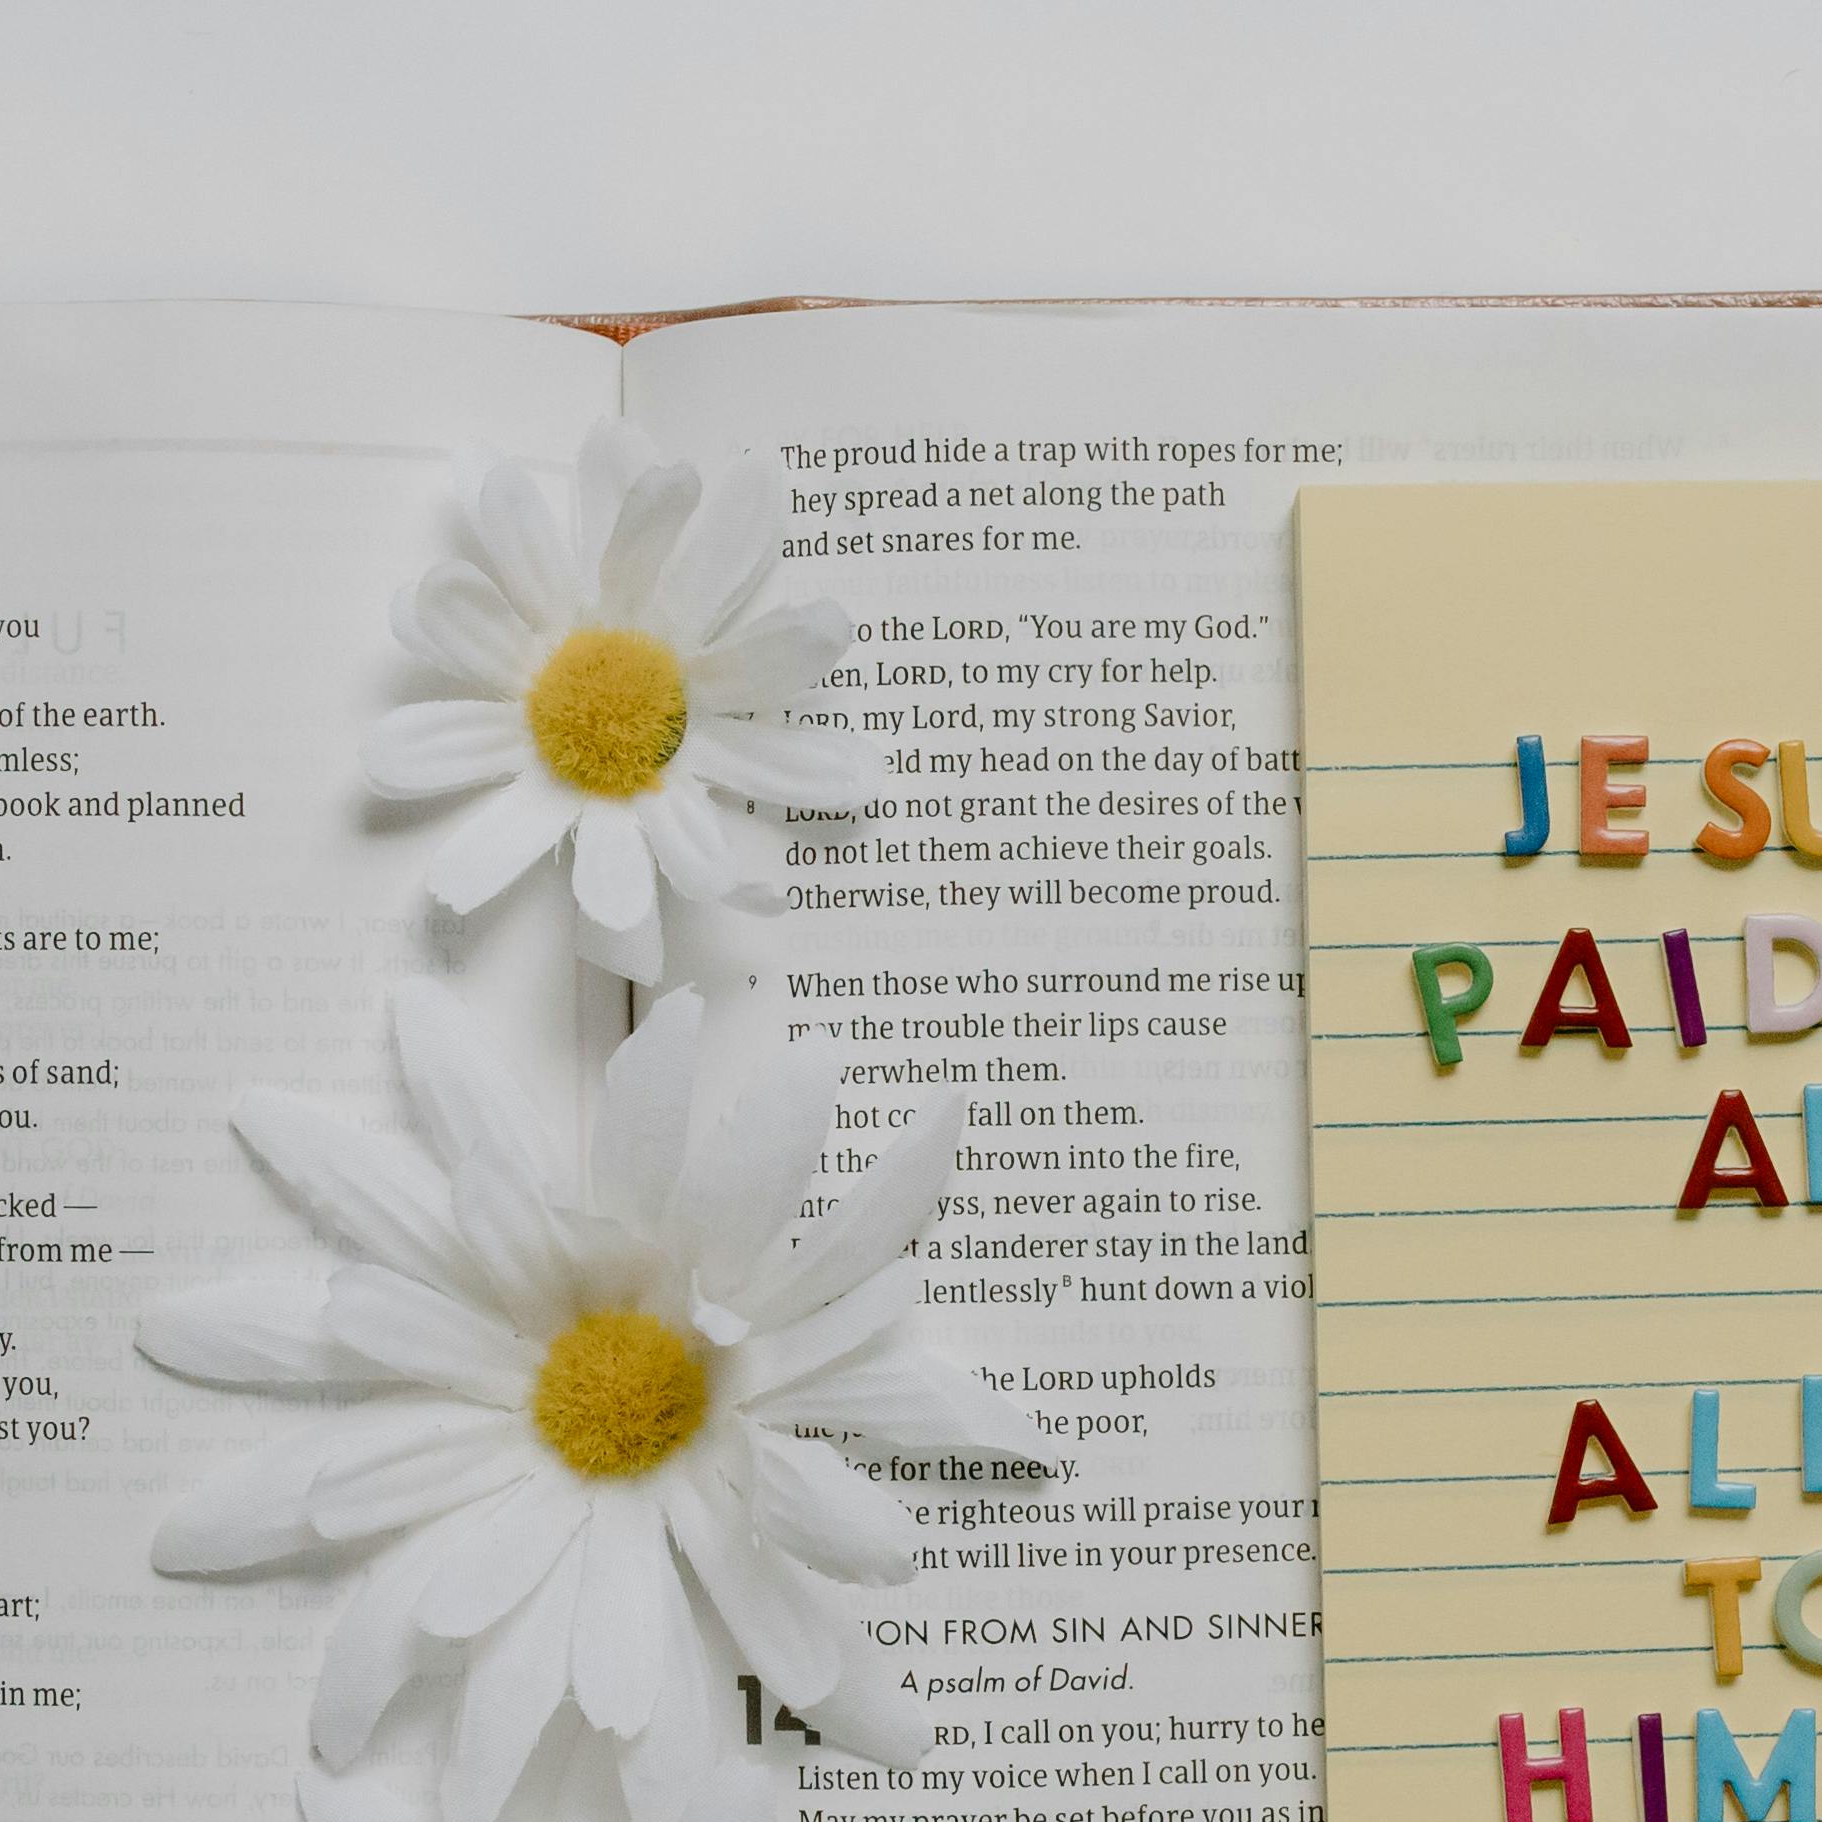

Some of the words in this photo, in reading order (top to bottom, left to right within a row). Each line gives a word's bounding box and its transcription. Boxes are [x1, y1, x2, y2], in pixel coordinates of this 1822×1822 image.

[779, 442, 828, 471] The
[831, 436, 918, 475] proud
[922, 435, 987, 465] hide
[993, 441, 1011, 463] a
[1016, 438, 1077, 469] trap
[1082, 435, 1151, 463] with
[1156, 441, 1237, 470] ropes
[1242, 435, 1287, 464] for
[1290, 442, 1344, 468] me;
[780, 529, 831, 560] and
[835, 530, 876, 557] set
[881, 530, 975, 555] snares
[981, 523, 1026, 552] for
[1030, 530, 1082, 552] me.
[943, 1617, 1039, 1646] FROM
[1051, 1615, 1106, 1645] SIN
[1118, 1614, 1195, 1643] AND
[899, 1668, 920, 1695] A
[925, 1664, 1006, 1703] psalm
[1013, 1663, 1045, 1694] of
[1048, 1661, 1135, 1693] David.
[796, 1764, 881, 1792] Listen
[885, 1762, 915, 1792] to
[920, 1769, 967, 1797] my
[970, 1762, 1049, 1790] voice
[1053, 1760, 1137, 1789] when
[1141, 1759, 1153, 1787] I
[1158, 1757, 1210, 1786] call
[1214, 1762, 1253, 1785] on
[1256, 1760, 1318, 1789] you.
